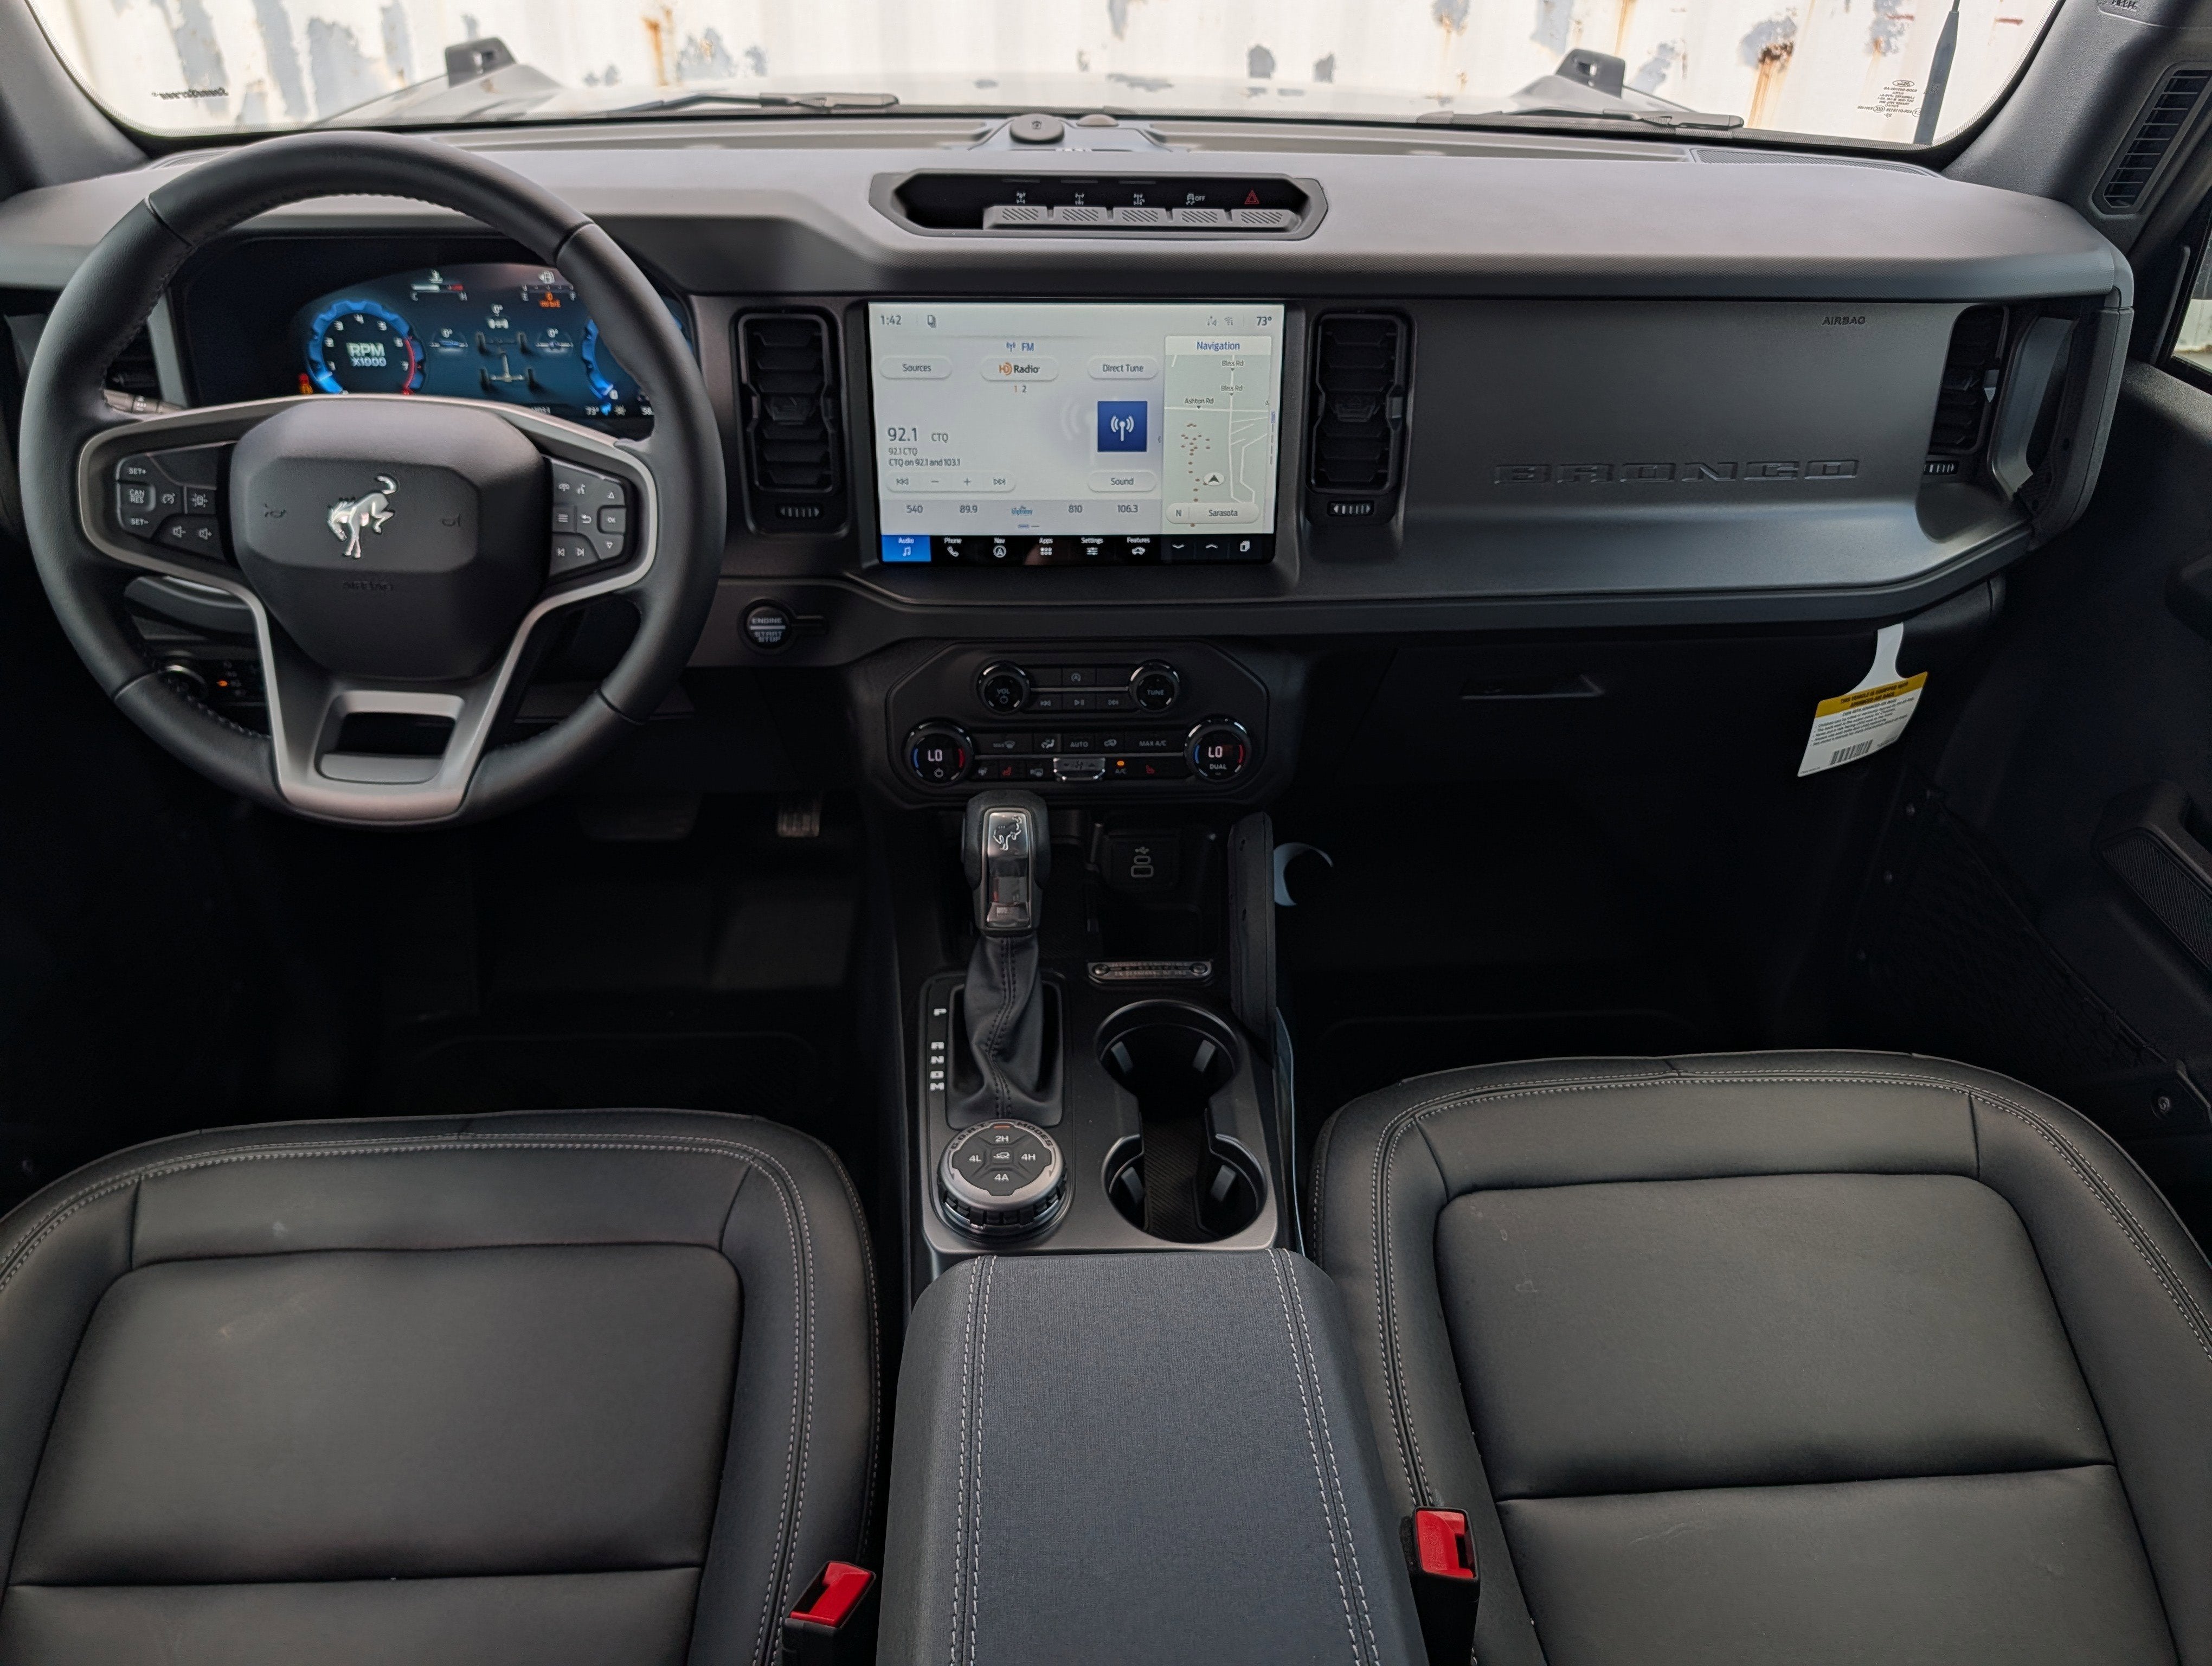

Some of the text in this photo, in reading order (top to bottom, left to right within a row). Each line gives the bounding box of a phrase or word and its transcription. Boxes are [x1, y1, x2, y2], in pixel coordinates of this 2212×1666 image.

[880, 315, 902, 325] 1:42
[1256, 316, 1272, 326] 73°
[1822, 316, 1866, 325] AIRBAG
[346, 342, 385, 357] RPM
[1021, 343, 1034, 351] FM
[1196, 341, 1240, 351] Navigation
[902, 363, 931, 373] Sources
[1102, 364, 1144, 373] Direct Tune
[1022, 385, 1027, 393] 2
[888, 427, 918, 442] 92.1
[930, 433, 949, 443] CTQ
[903, 448, 918, 456] CTQ
[889, 459, 904, 467] CTQ
[1494, 459, 1860, 484] BRONCO
[1110, 477, 1134, 486] Sound
[906, 505, 923, 514] 540
[960, 505, 978, 514] 89.9
[1068, 505, 1083, 514] 810
[1117, 505, 1139, 514] 106.3
[927, 749, 943, 762] LO
[1208, 746, 1223, 758] LO
[934, 1008, 947, 1016] P
[930, 1055, 944, 1065] N
[929, 1082, 945, 1091] M
[1017, 1122, 1053, 1146] MODES
[995, 1135, 1009, 1143] 2H
[994, 1174, 1009, 1182] 4A
